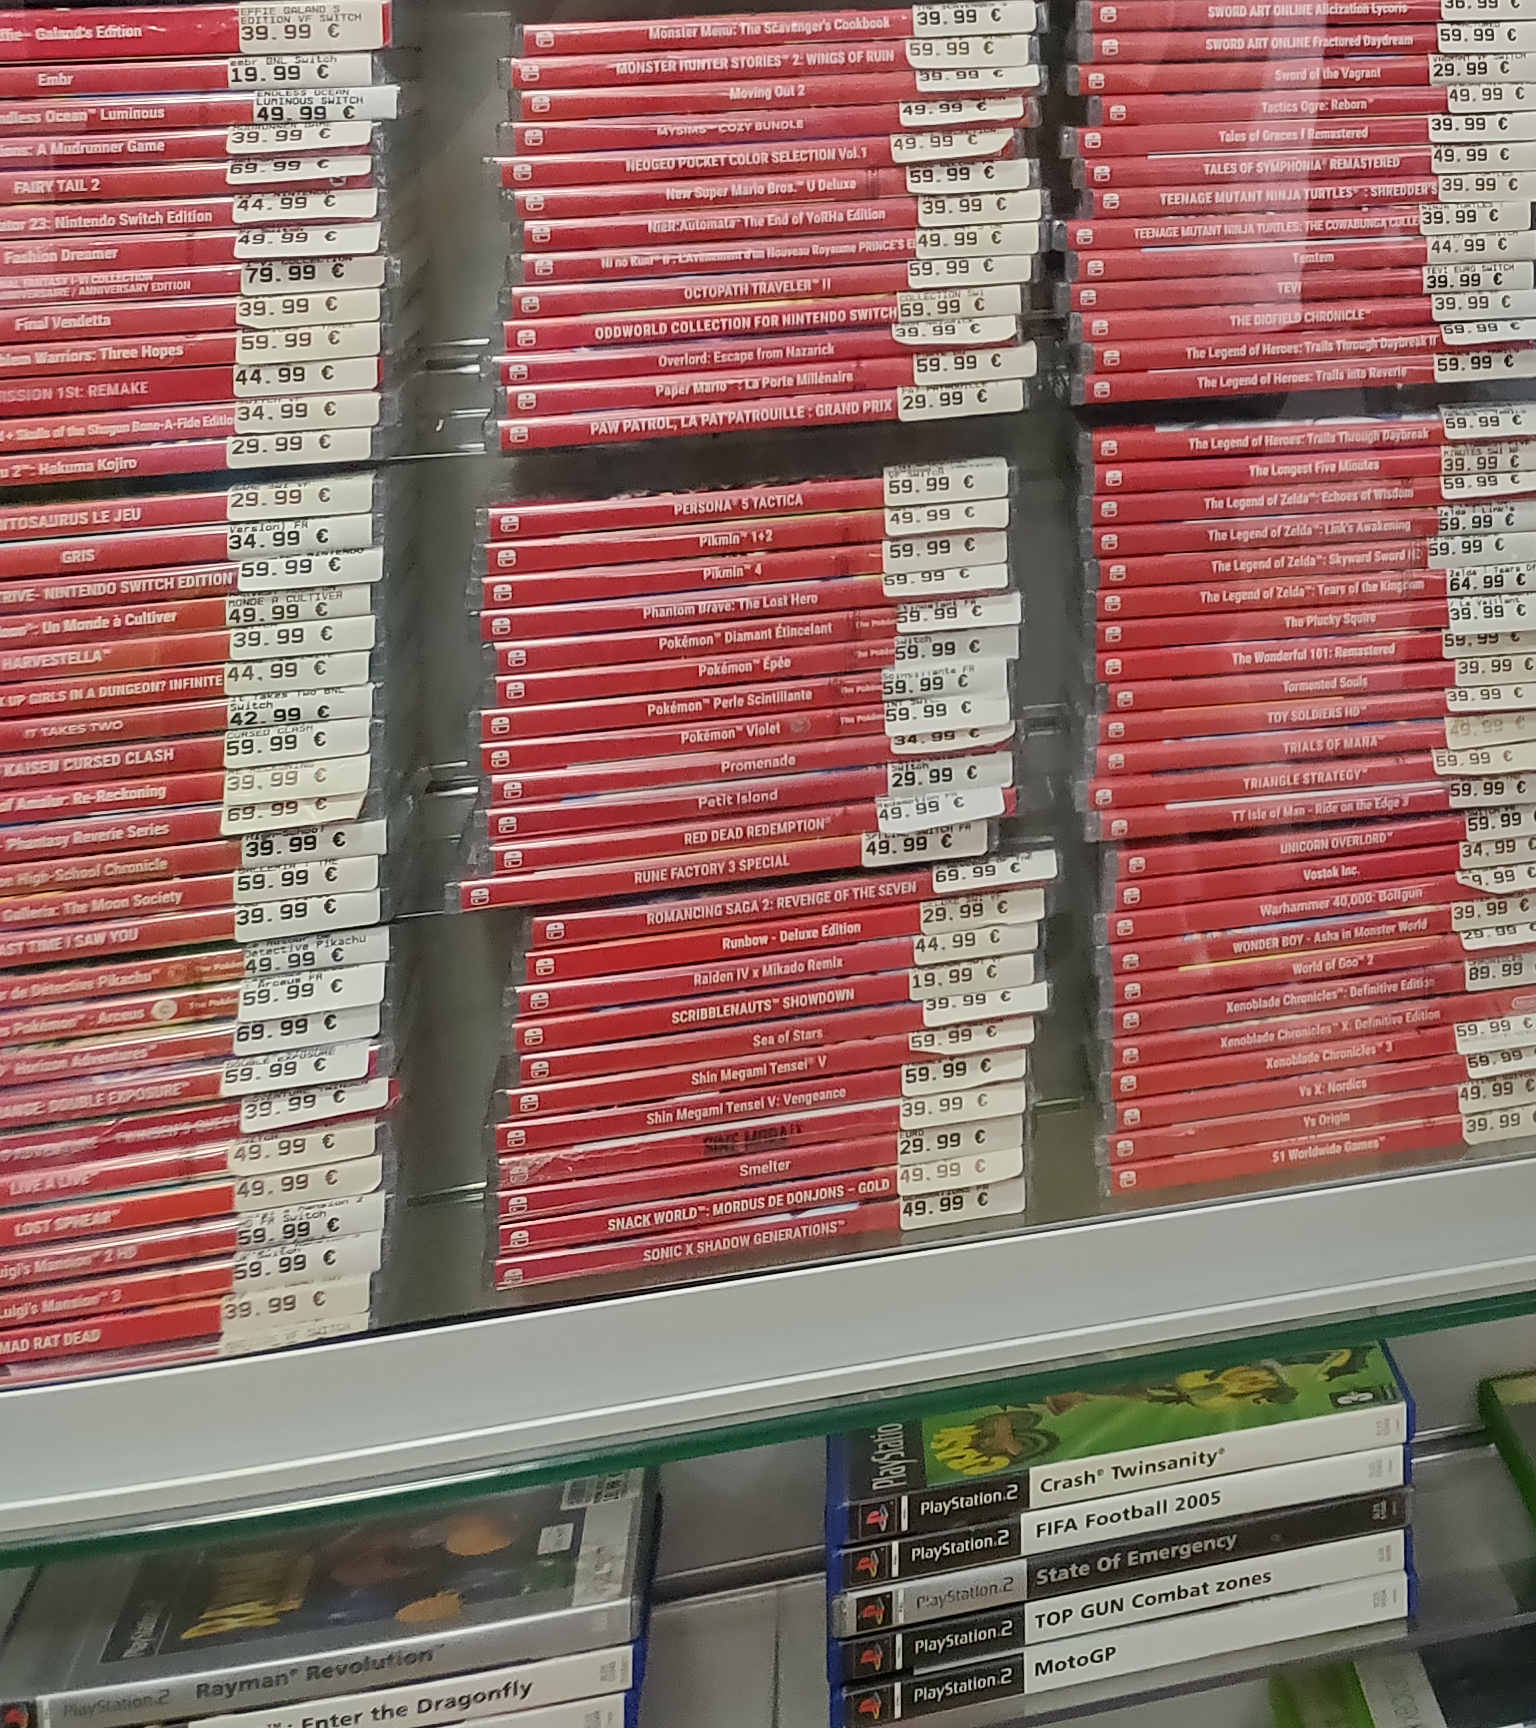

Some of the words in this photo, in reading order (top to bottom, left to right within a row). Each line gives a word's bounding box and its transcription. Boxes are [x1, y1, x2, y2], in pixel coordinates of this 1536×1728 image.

[38, 73, 73, 88] Embr
[231, 65, 301, 83] 19.99
[317, 65, 328, 79] €
[14, 178, 52, 193] FAIRY
[57, 178, 87, 192] TAIL
[89, 178, 100, 191] 2
[658, 351, 710, 367] Overlord:
[713, 349, 752, 365] Escape
[755, 348, 783, 361] from
[787, 342, 835, 358] Nazarick
[61, 549, 94, 563] GRIS
[1450, 574, 1504, 591] 64.99
[1516, 572, 1526, 586] €
[721, 755, 796, 773] Promenade
[634, 869, 669, 884] RUNE
[673, 862, 725, 881] FACTORY
[729, 860, 738, 875] 3
[741, 854, 790, 873] SPECIAL
[1303, 866, 1338, 881] Vostok
[753, 1033, 775, 1048] Sea
[779, 1031, 791, 1045] of
[793, 1026, 823, 1043] Stars
[740, 1158, 791, 1177] Smelter
[1041, 1471, 1095, 1492] Crash
[1111, 1450, 1219, 1481] Twinsanity
[1036, 1518, 1078, 1539] FIFA
[1085, 1499, 1168, 1529] Football
[1175, 1491, 1222, 1512] 2005
[1036, 1562, 1089, 1586] State
[1098, 1553, 1121, 1574] Of
[1128, 1531, 1237, 1568] Emergency
[1036, 1608, 1073, 1629] TOP
[1080, 1597, 1125, 1621] GUN
[1132, 1580, 1210, 1611] Combat
[1214, 1570, 1272, 1595] zones
[1035, 1646, 1116, 1677] MotoGP
[197, 1671, 291, 1700] Rayman
[306, 1648, 434, 1683] Revolution
